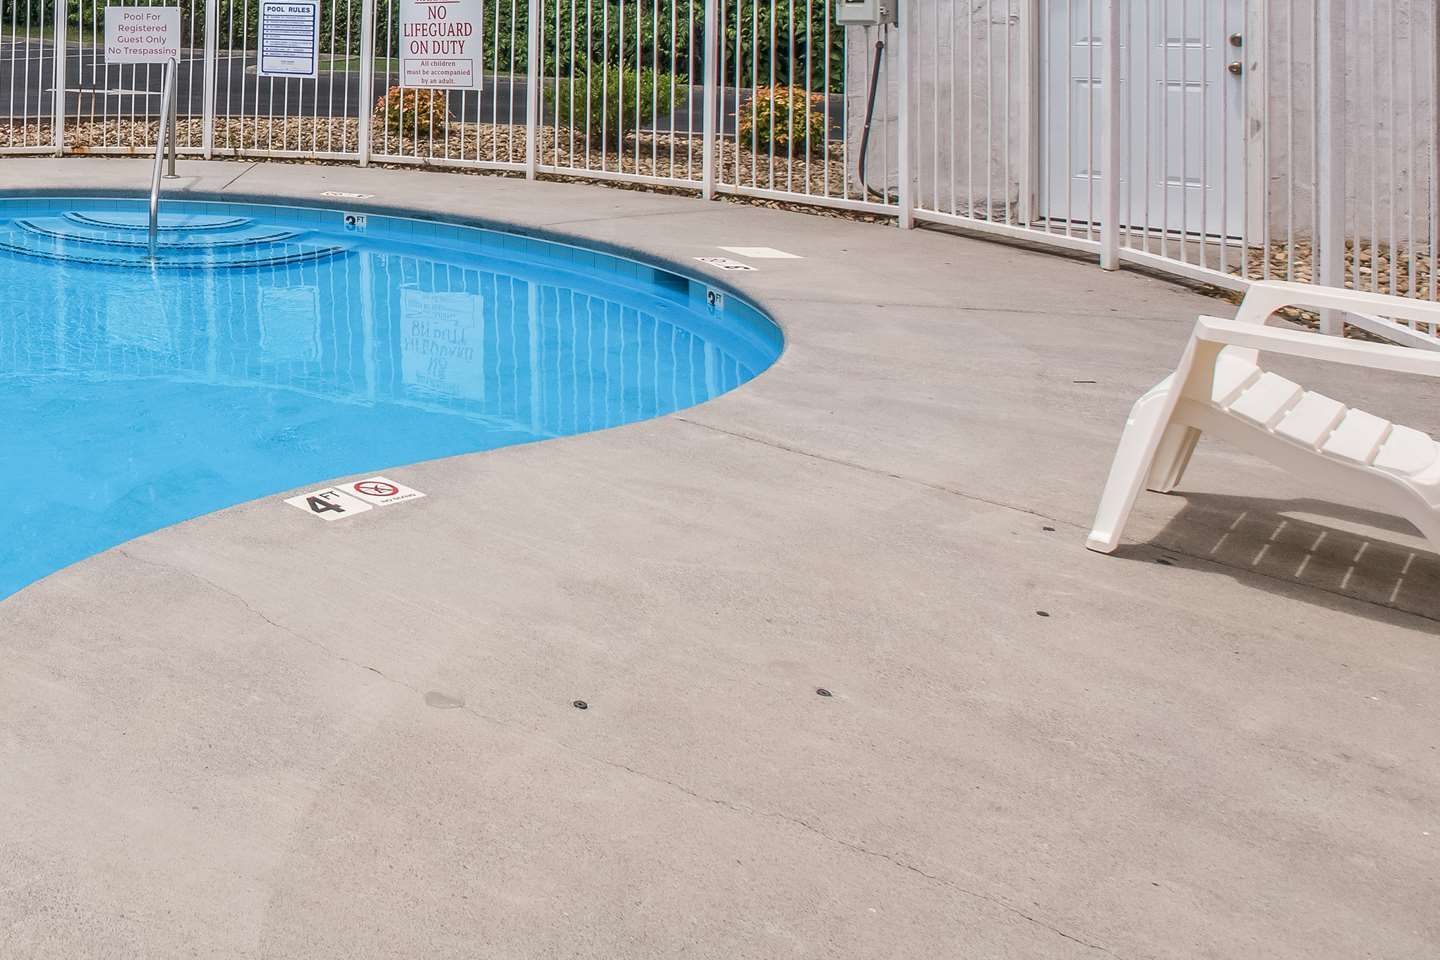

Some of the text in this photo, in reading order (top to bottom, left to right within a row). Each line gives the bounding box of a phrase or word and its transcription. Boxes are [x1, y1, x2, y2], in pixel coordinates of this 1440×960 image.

[123, 12, 144, 21] Pool
[427, 5, 447, 20] NO
[118, 24, 167, 33] Registered
[403, 22, 473, 37] LIFEGUARD
[117, 35, 167, 45] Guest Only
[124, 47, 177, 56] Trespassing
[410, 40, 465, 55] ON DUTY
[430, 68, 471, 76] accompanied
[306, 490, 346, 513] 4 FT
